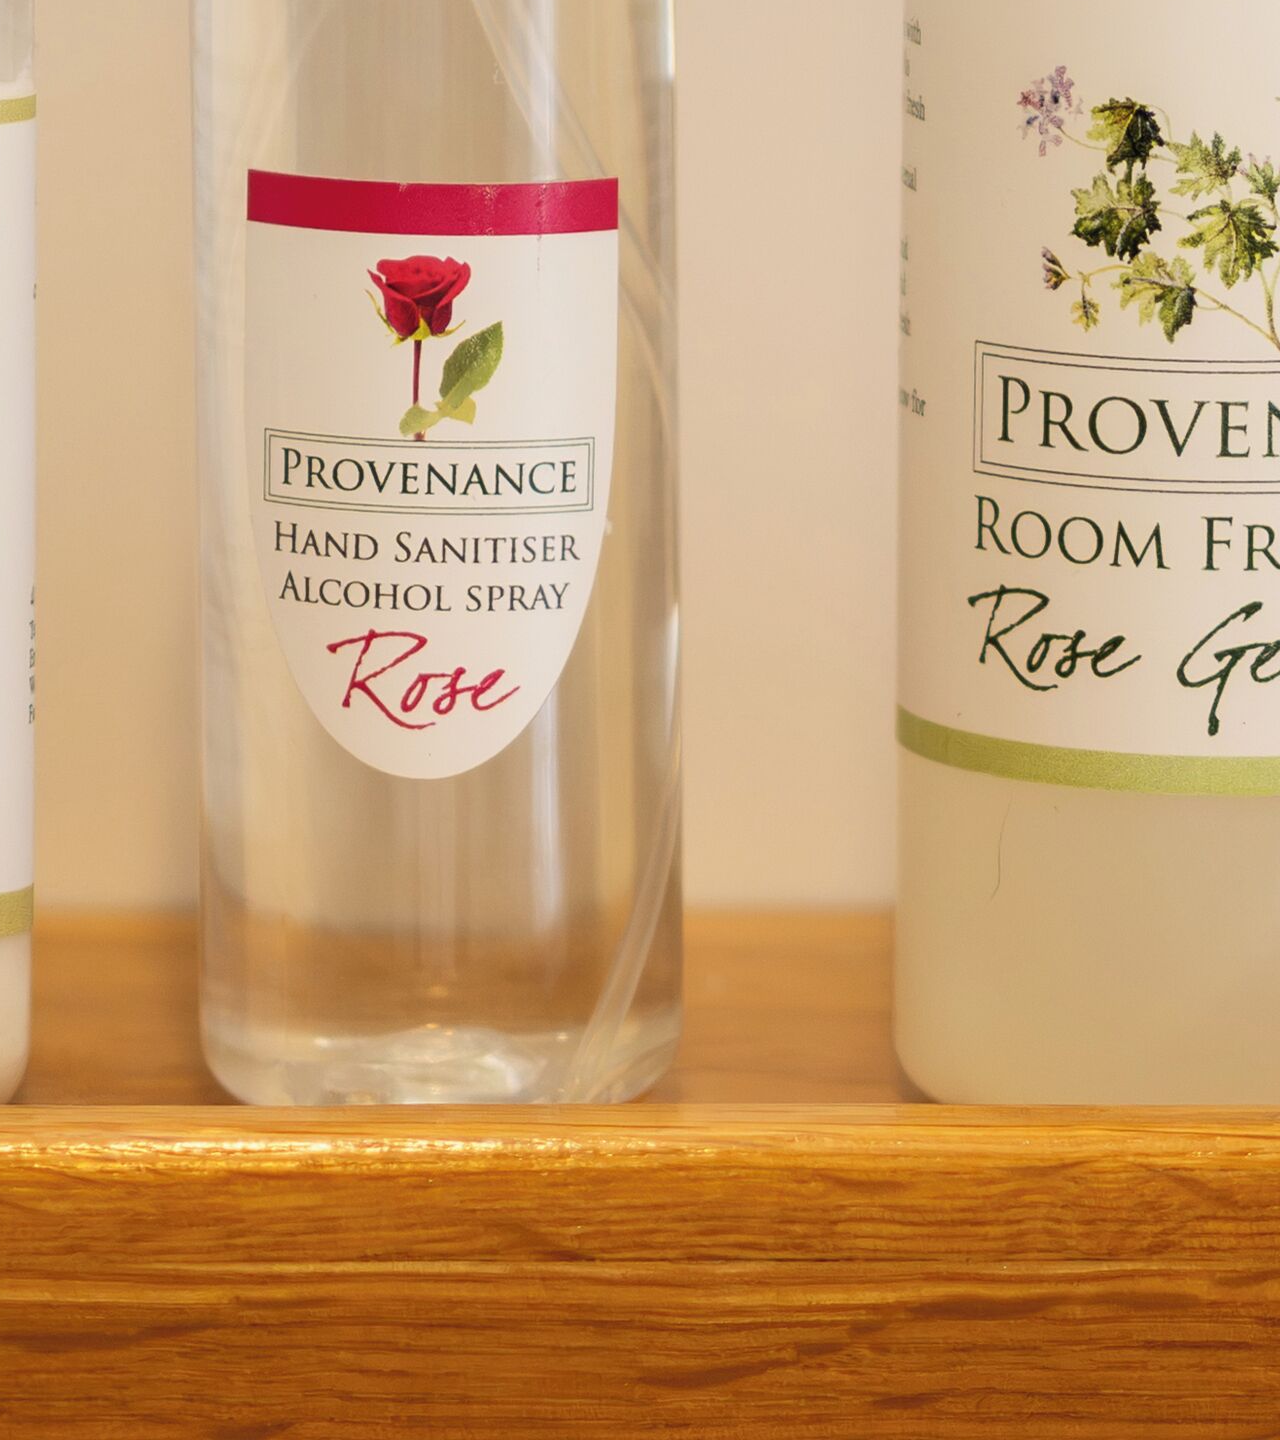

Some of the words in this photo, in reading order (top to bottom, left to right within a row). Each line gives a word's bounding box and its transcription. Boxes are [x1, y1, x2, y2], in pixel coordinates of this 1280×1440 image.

[281, 446, 577, 496] PROVENANCE
[274, 520, 379, 561] HAND
[394, 531, 581, 564] SANITISER
[974, 495, 1171, 570] ROOM
[278, 569, 452, 613] ALCOHOL
[465, 582, 571, 612] SPRAY
[967, 584, 1142, 693] Rose
[326, 628, 521, 730] Rose
